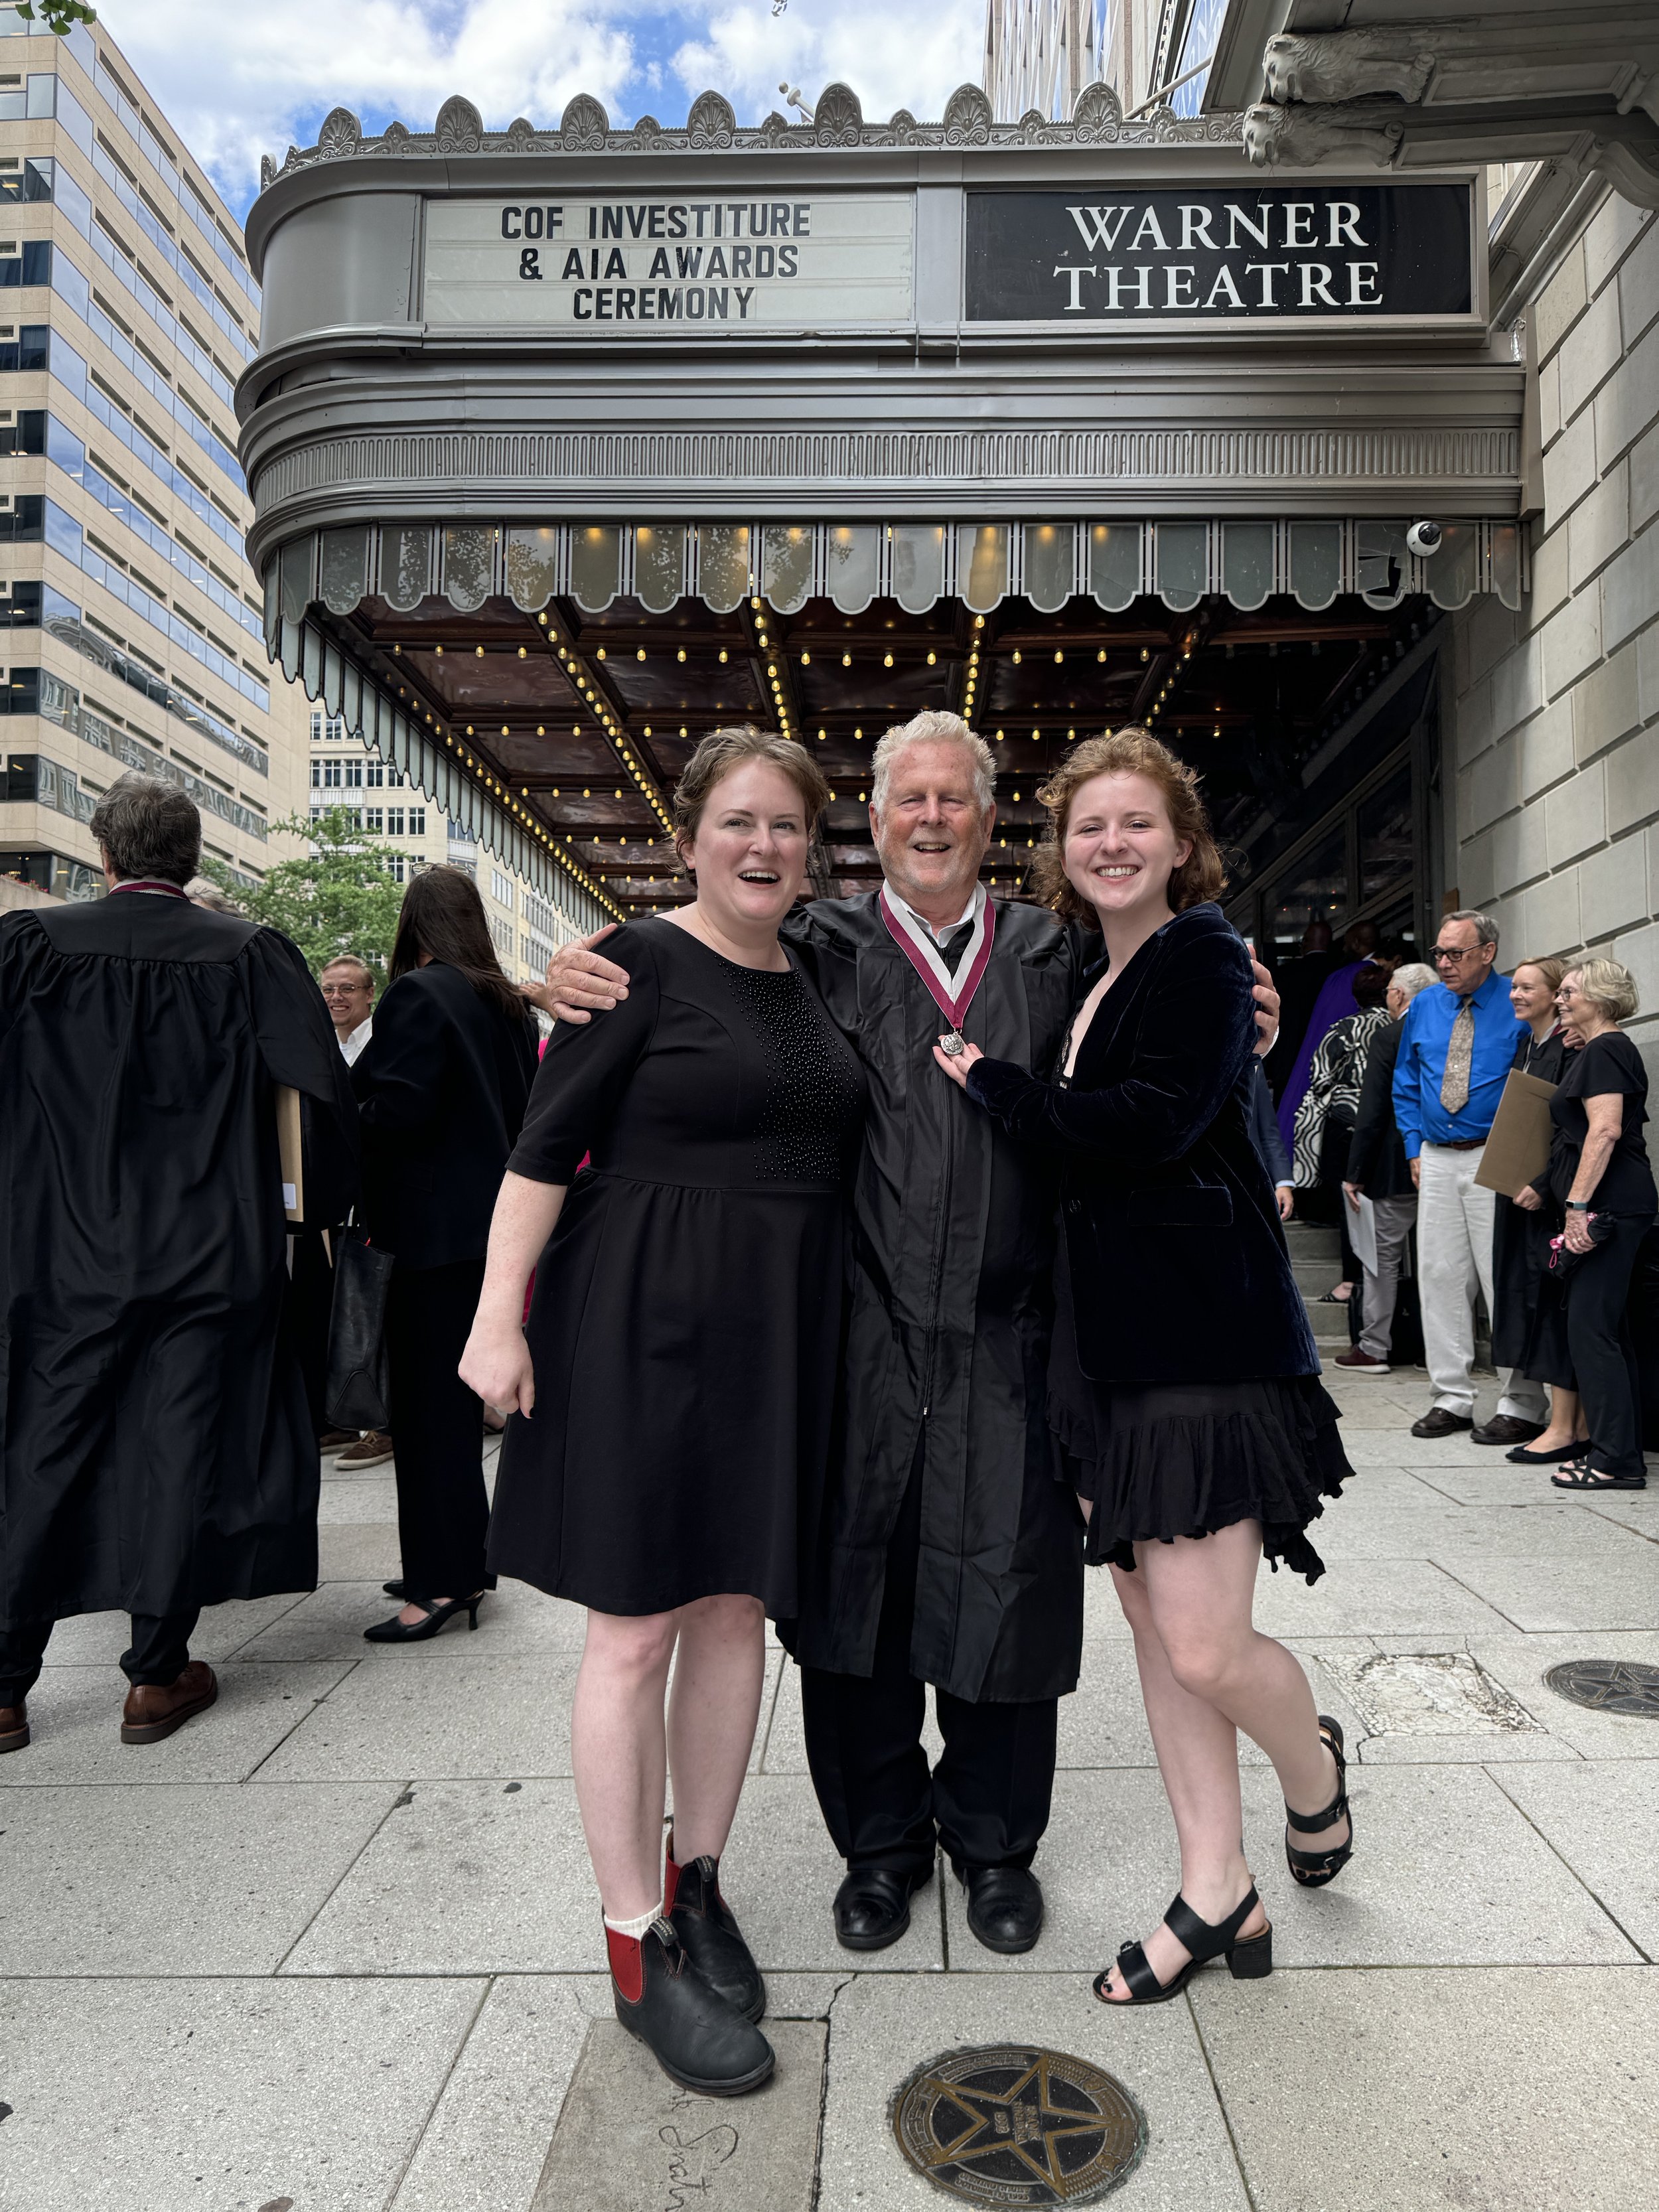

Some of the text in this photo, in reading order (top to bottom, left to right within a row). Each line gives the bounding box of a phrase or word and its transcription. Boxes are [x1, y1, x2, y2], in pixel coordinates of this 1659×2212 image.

[502, 203, 811, 240] COF INVESTITURE
[1065, 202, 1369, 252] WARNER
[519, 245, 799, 281] & AIA AWARDS
[573, 287, 755, 321] CEREMONY
[1052, 261, 1383, 310] THEATRE
